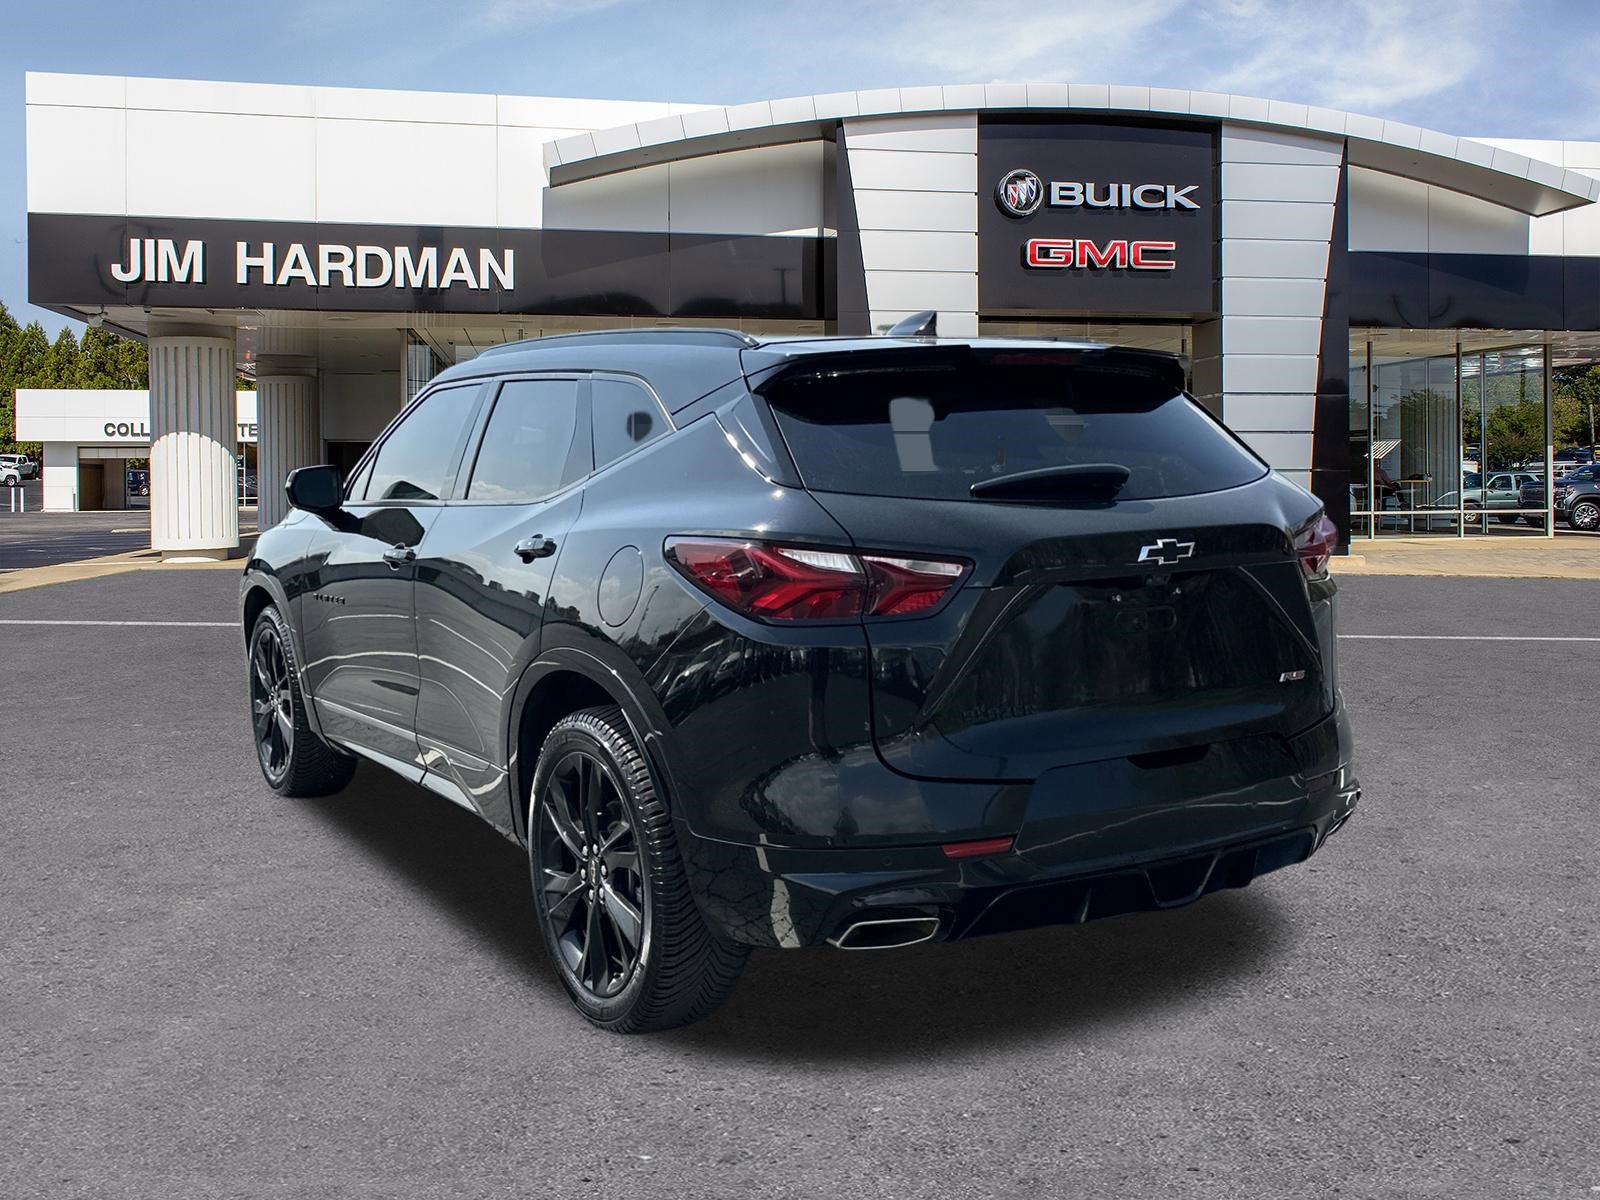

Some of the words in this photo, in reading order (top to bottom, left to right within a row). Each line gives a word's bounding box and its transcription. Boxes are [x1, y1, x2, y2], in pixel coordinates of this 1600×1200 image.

[1050, 181, 1200, 209] BUICK
[111, 238, 205, 284] JIM
[236, 241, 516, 291] HARDMAN
[1026, 238, 1176, 270] GMC
[104, 422, 150, 437] COLL
[237, 423, 257, 436] TE
